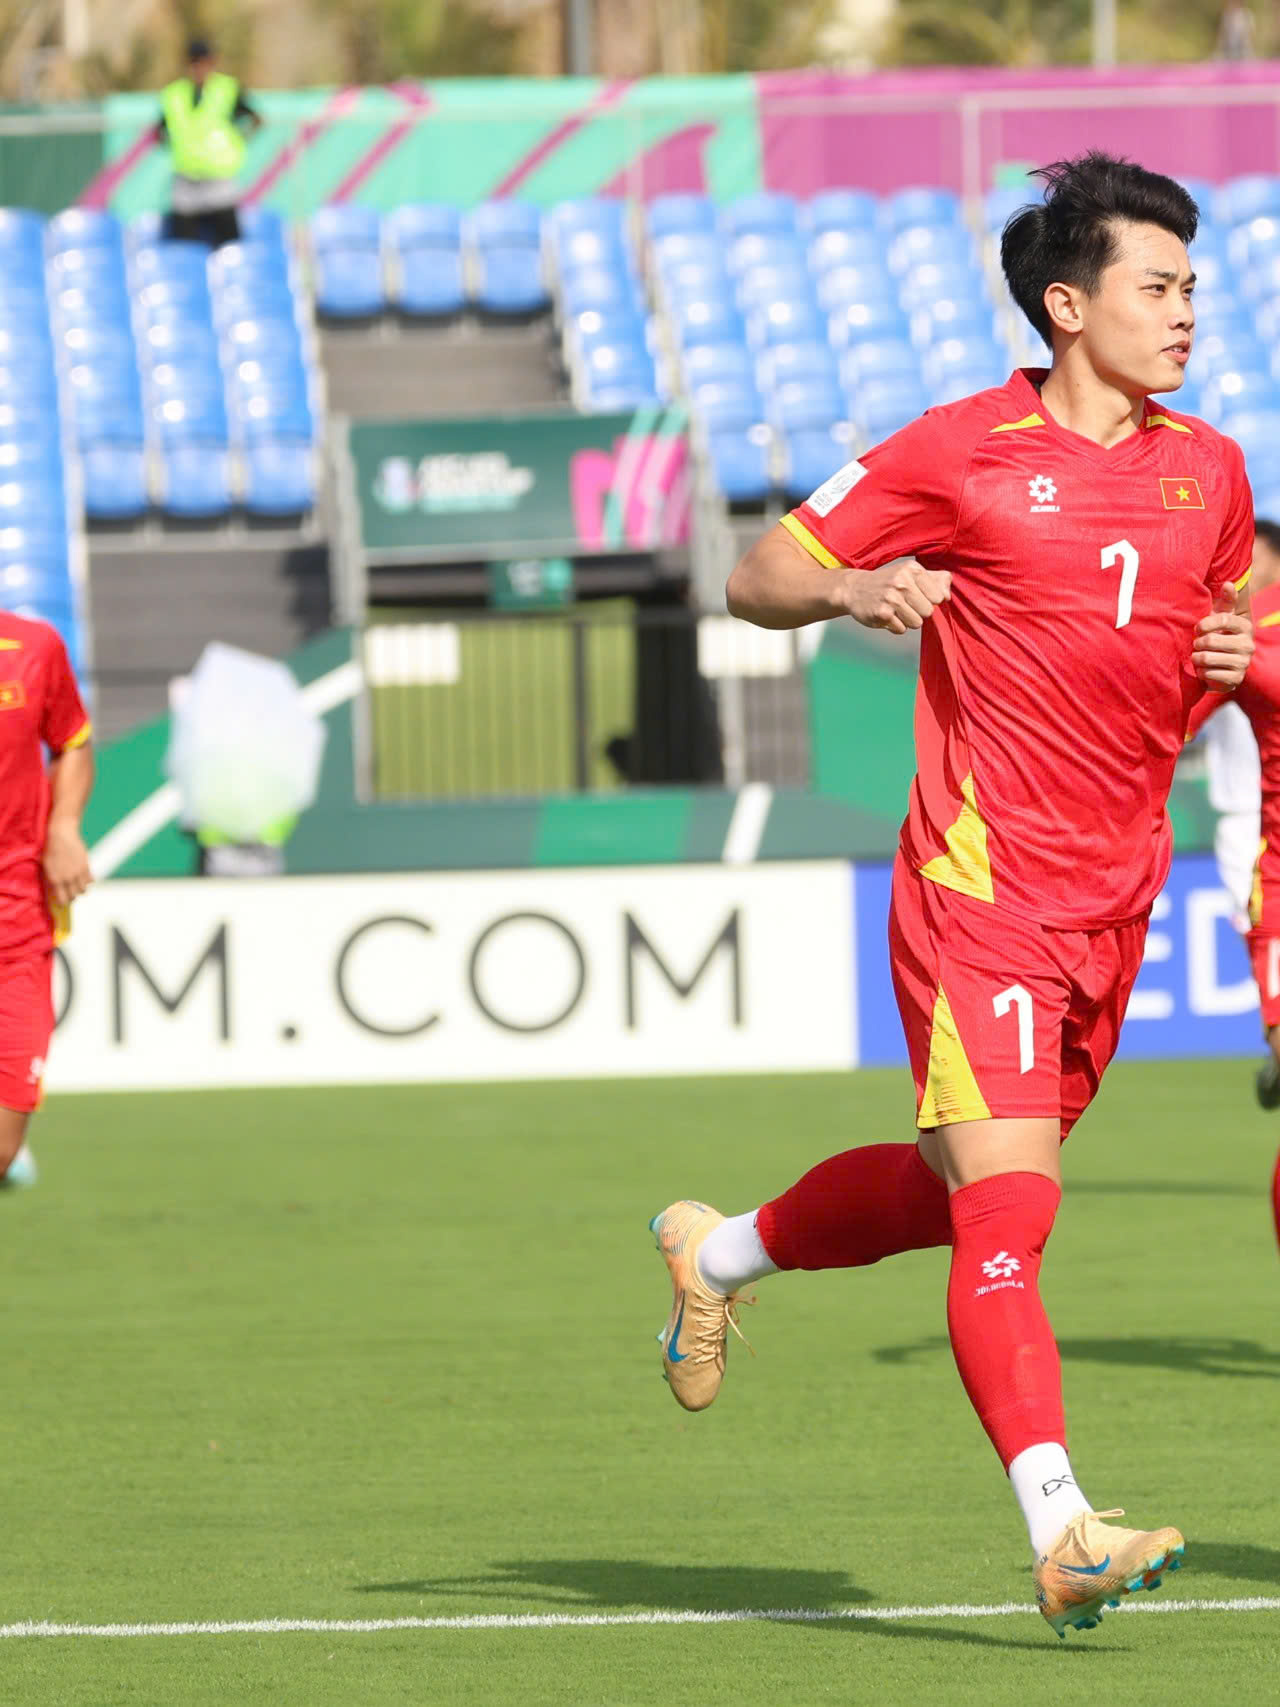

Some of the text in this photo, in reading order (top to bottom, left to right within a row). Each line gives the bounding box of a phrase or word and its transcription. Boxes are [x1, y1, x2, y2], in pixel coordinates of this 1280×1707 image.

[1100, 539, 1139, 630] 7
[52, 906, 744, 1046] M.COM
[992, 983, 1035, 1075] 7
